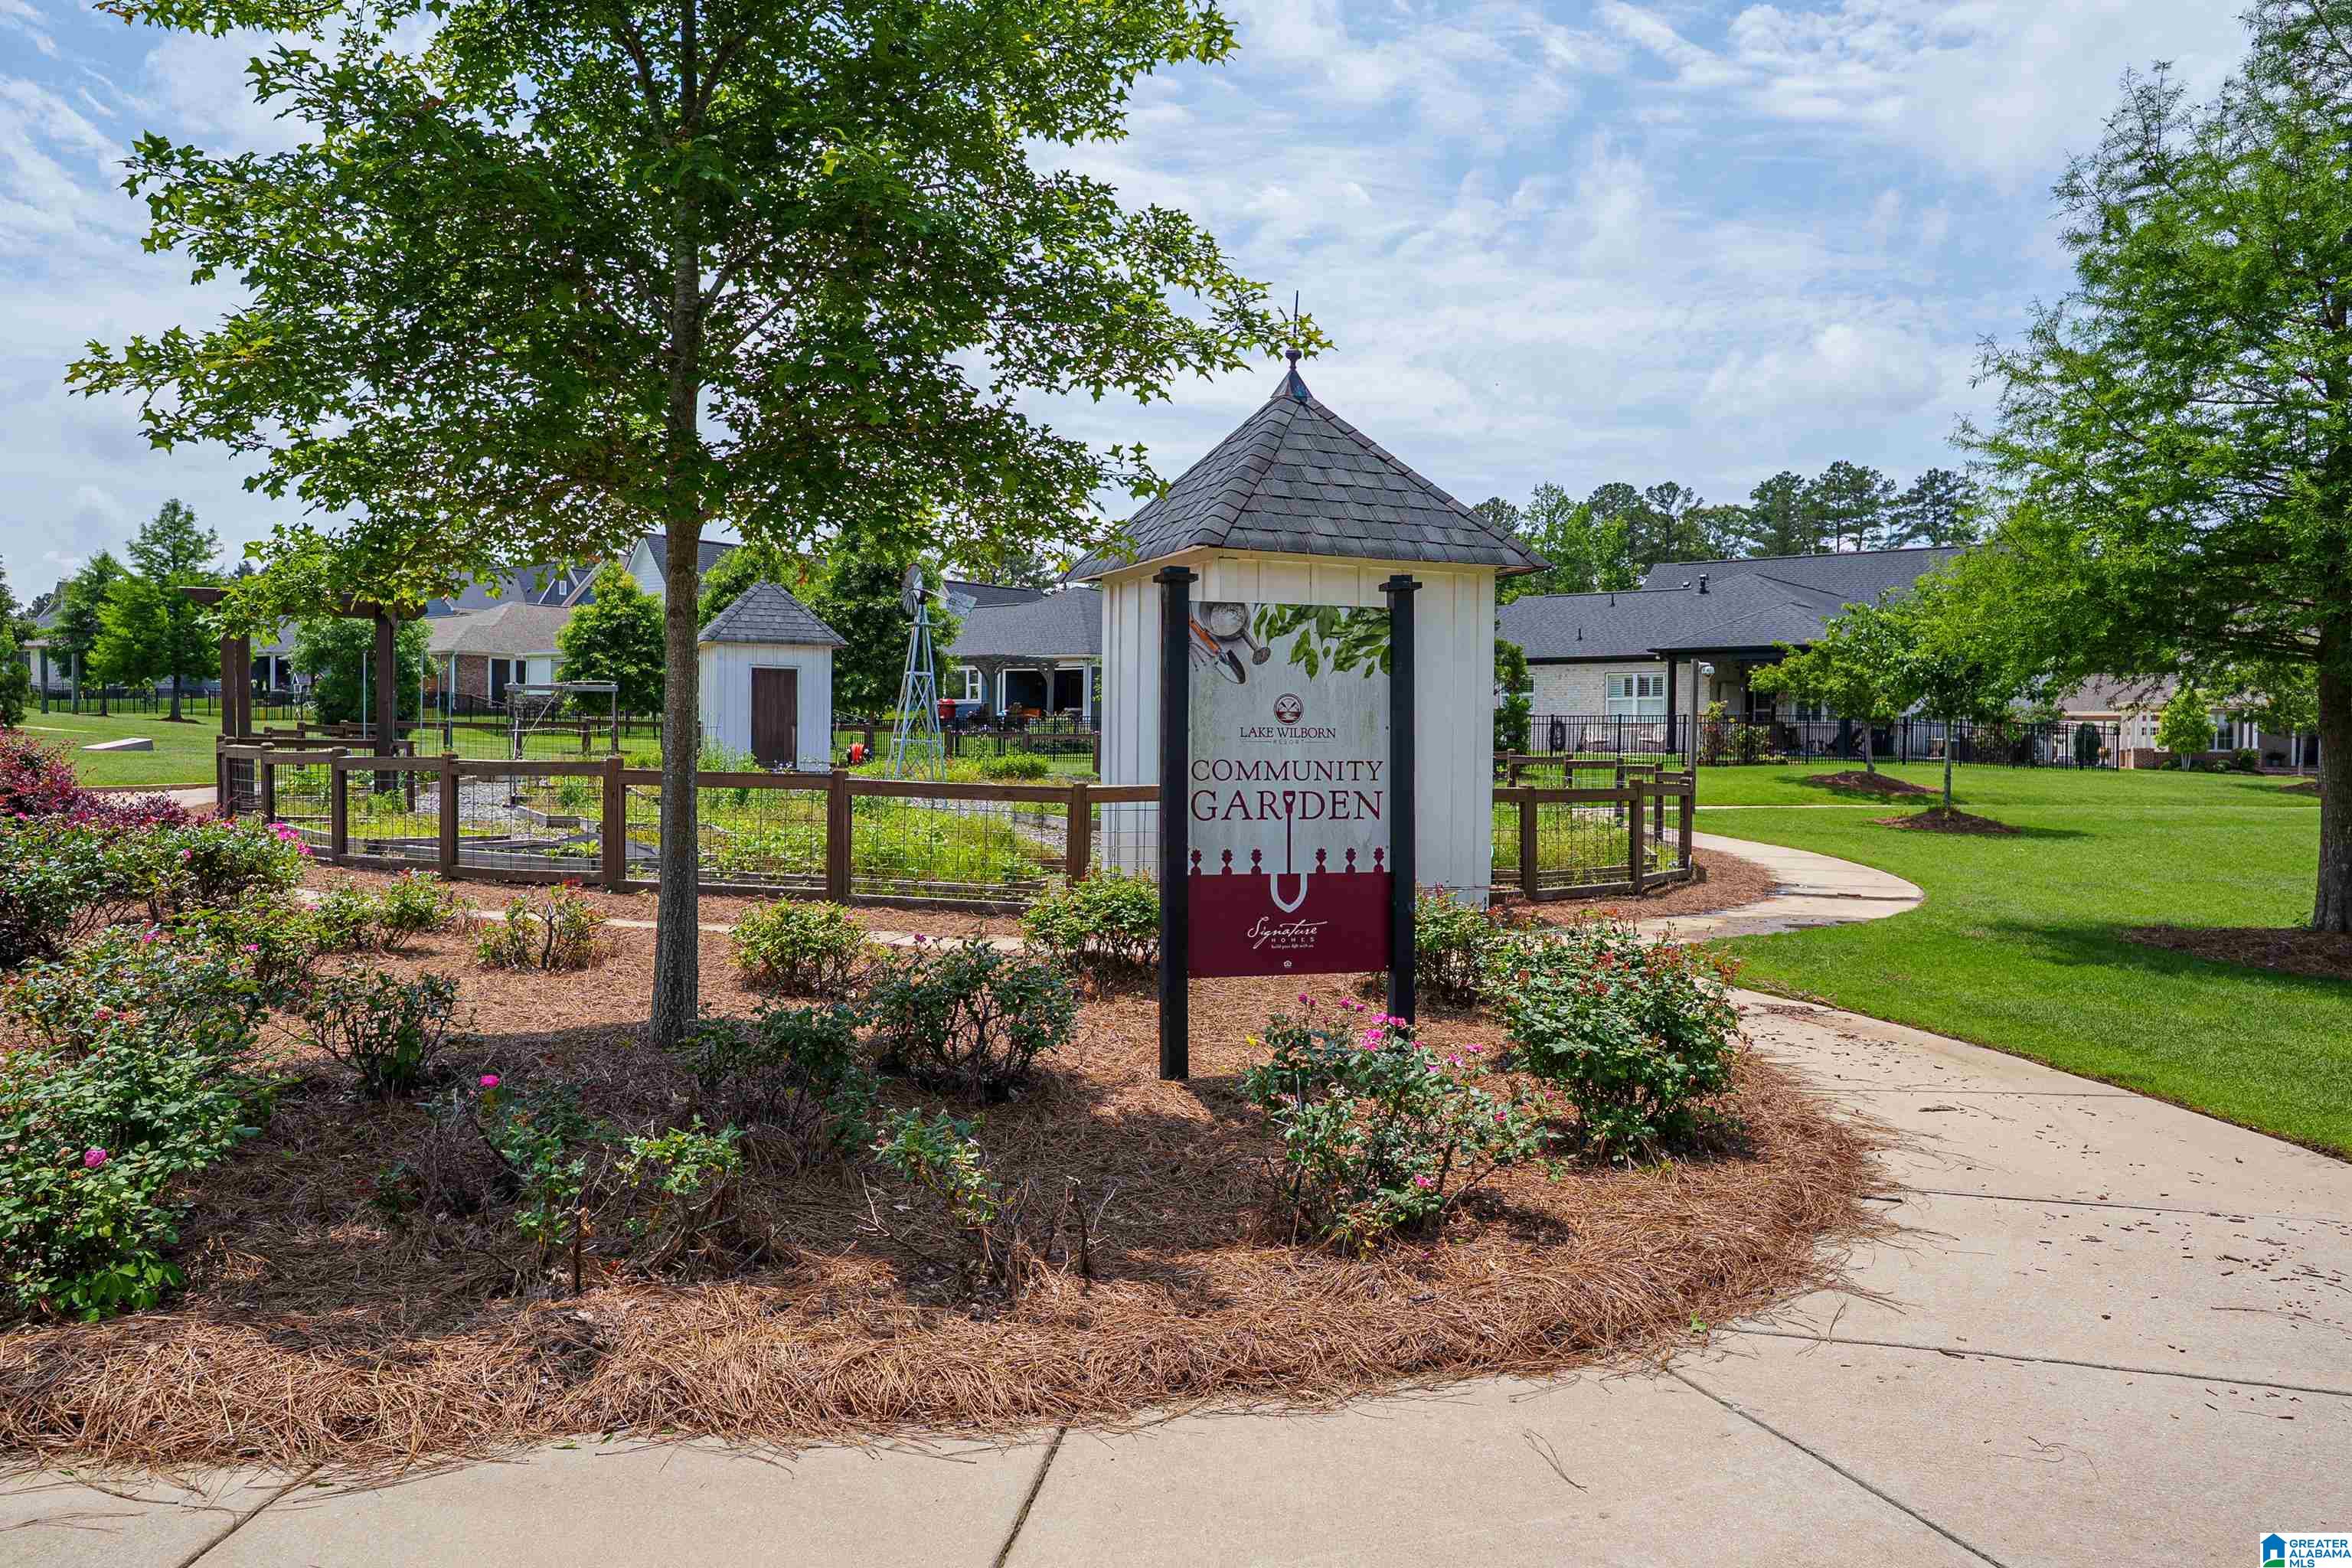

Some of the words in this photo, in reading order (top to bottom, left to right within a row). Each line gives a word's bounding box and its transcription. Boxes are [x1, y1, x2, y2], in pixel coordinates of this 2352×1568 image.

[1240, 727, 1274, 738] LAKE
[1276, 727, 1336, 739] WILBORN
[1191, 759, 1383, 782] COMMUNITY
[1190, 789, 1383, 822] GARDEN
[1247, 916, 1328, 949] Signature
